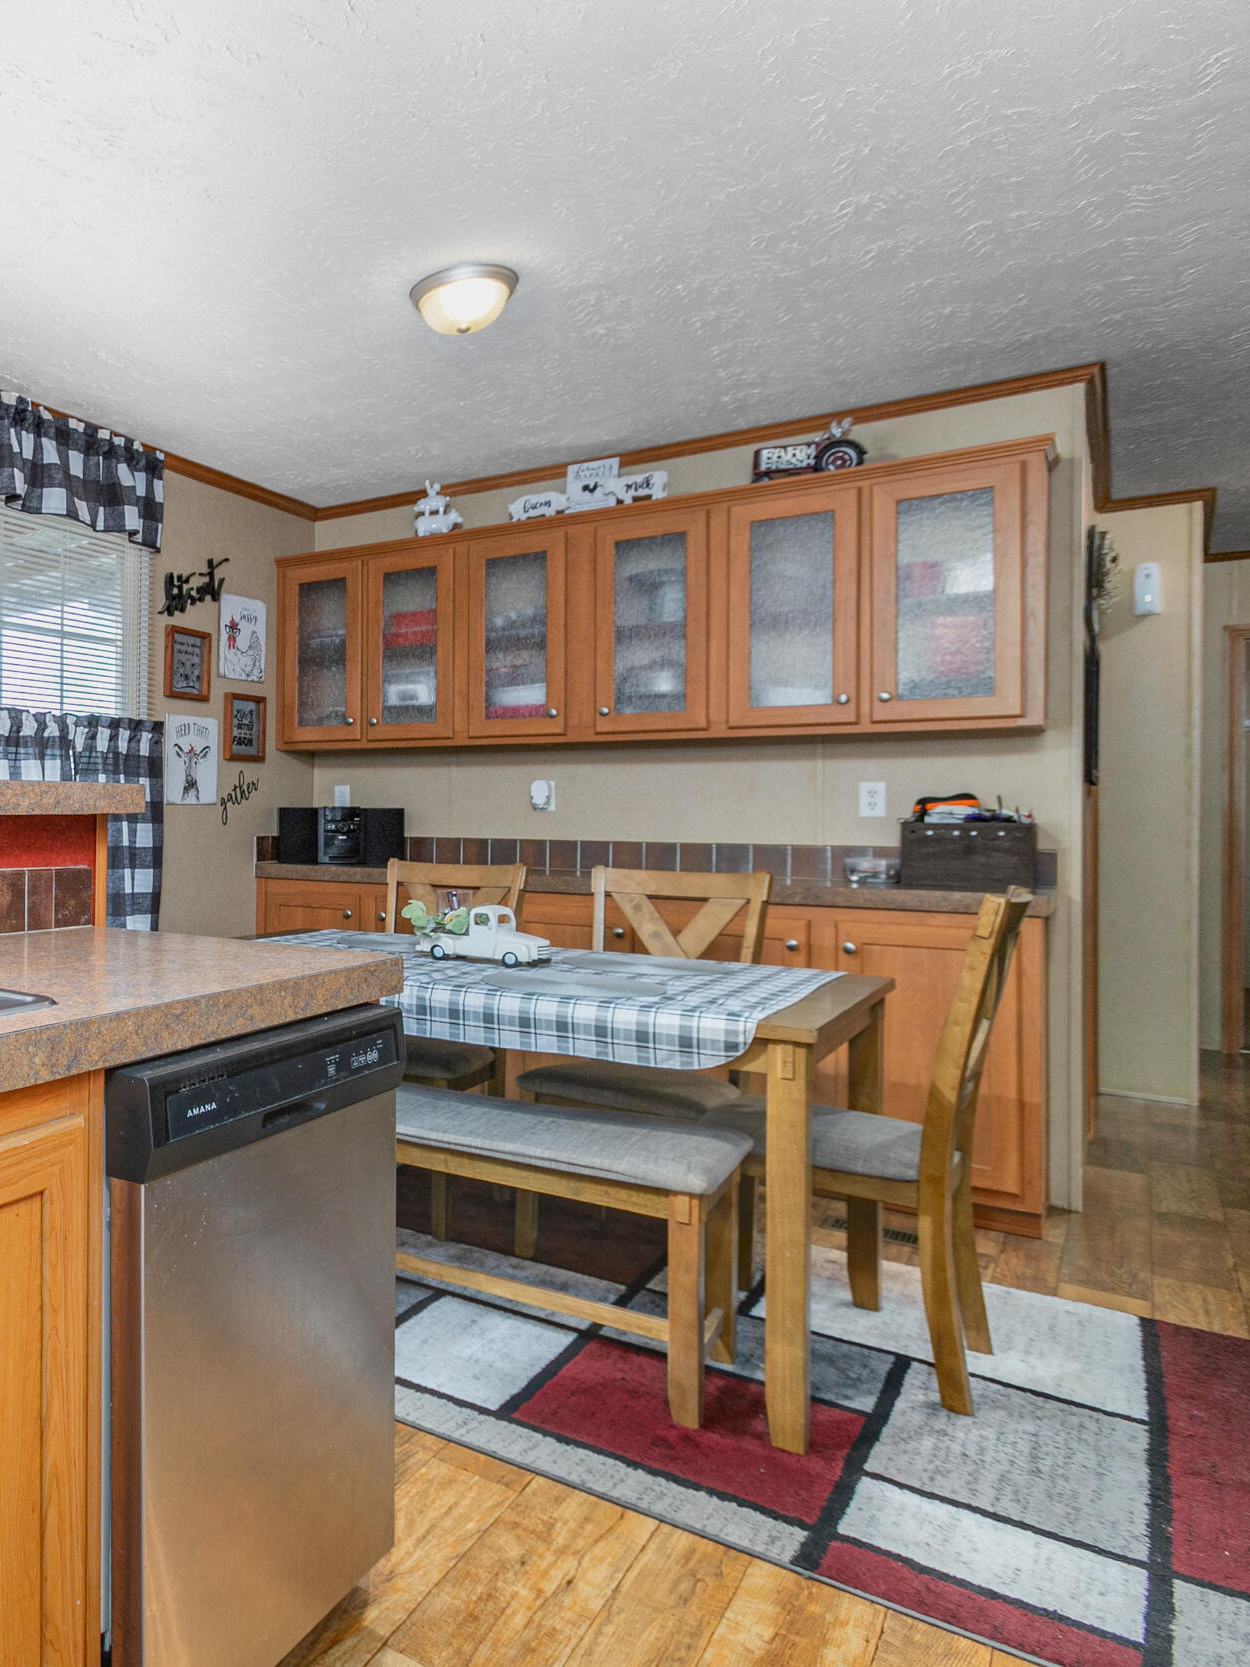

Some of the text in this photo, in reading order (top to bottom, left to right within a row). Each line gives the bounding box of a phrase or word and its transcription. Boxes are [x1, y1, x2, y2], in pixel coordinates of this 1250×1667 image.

[760, 444, 816, 461] FARM
[232, 735, 254, 747] FARM
[220, 769, 260, 826] gather
[186, 1101, 218, 1119] AMANA
